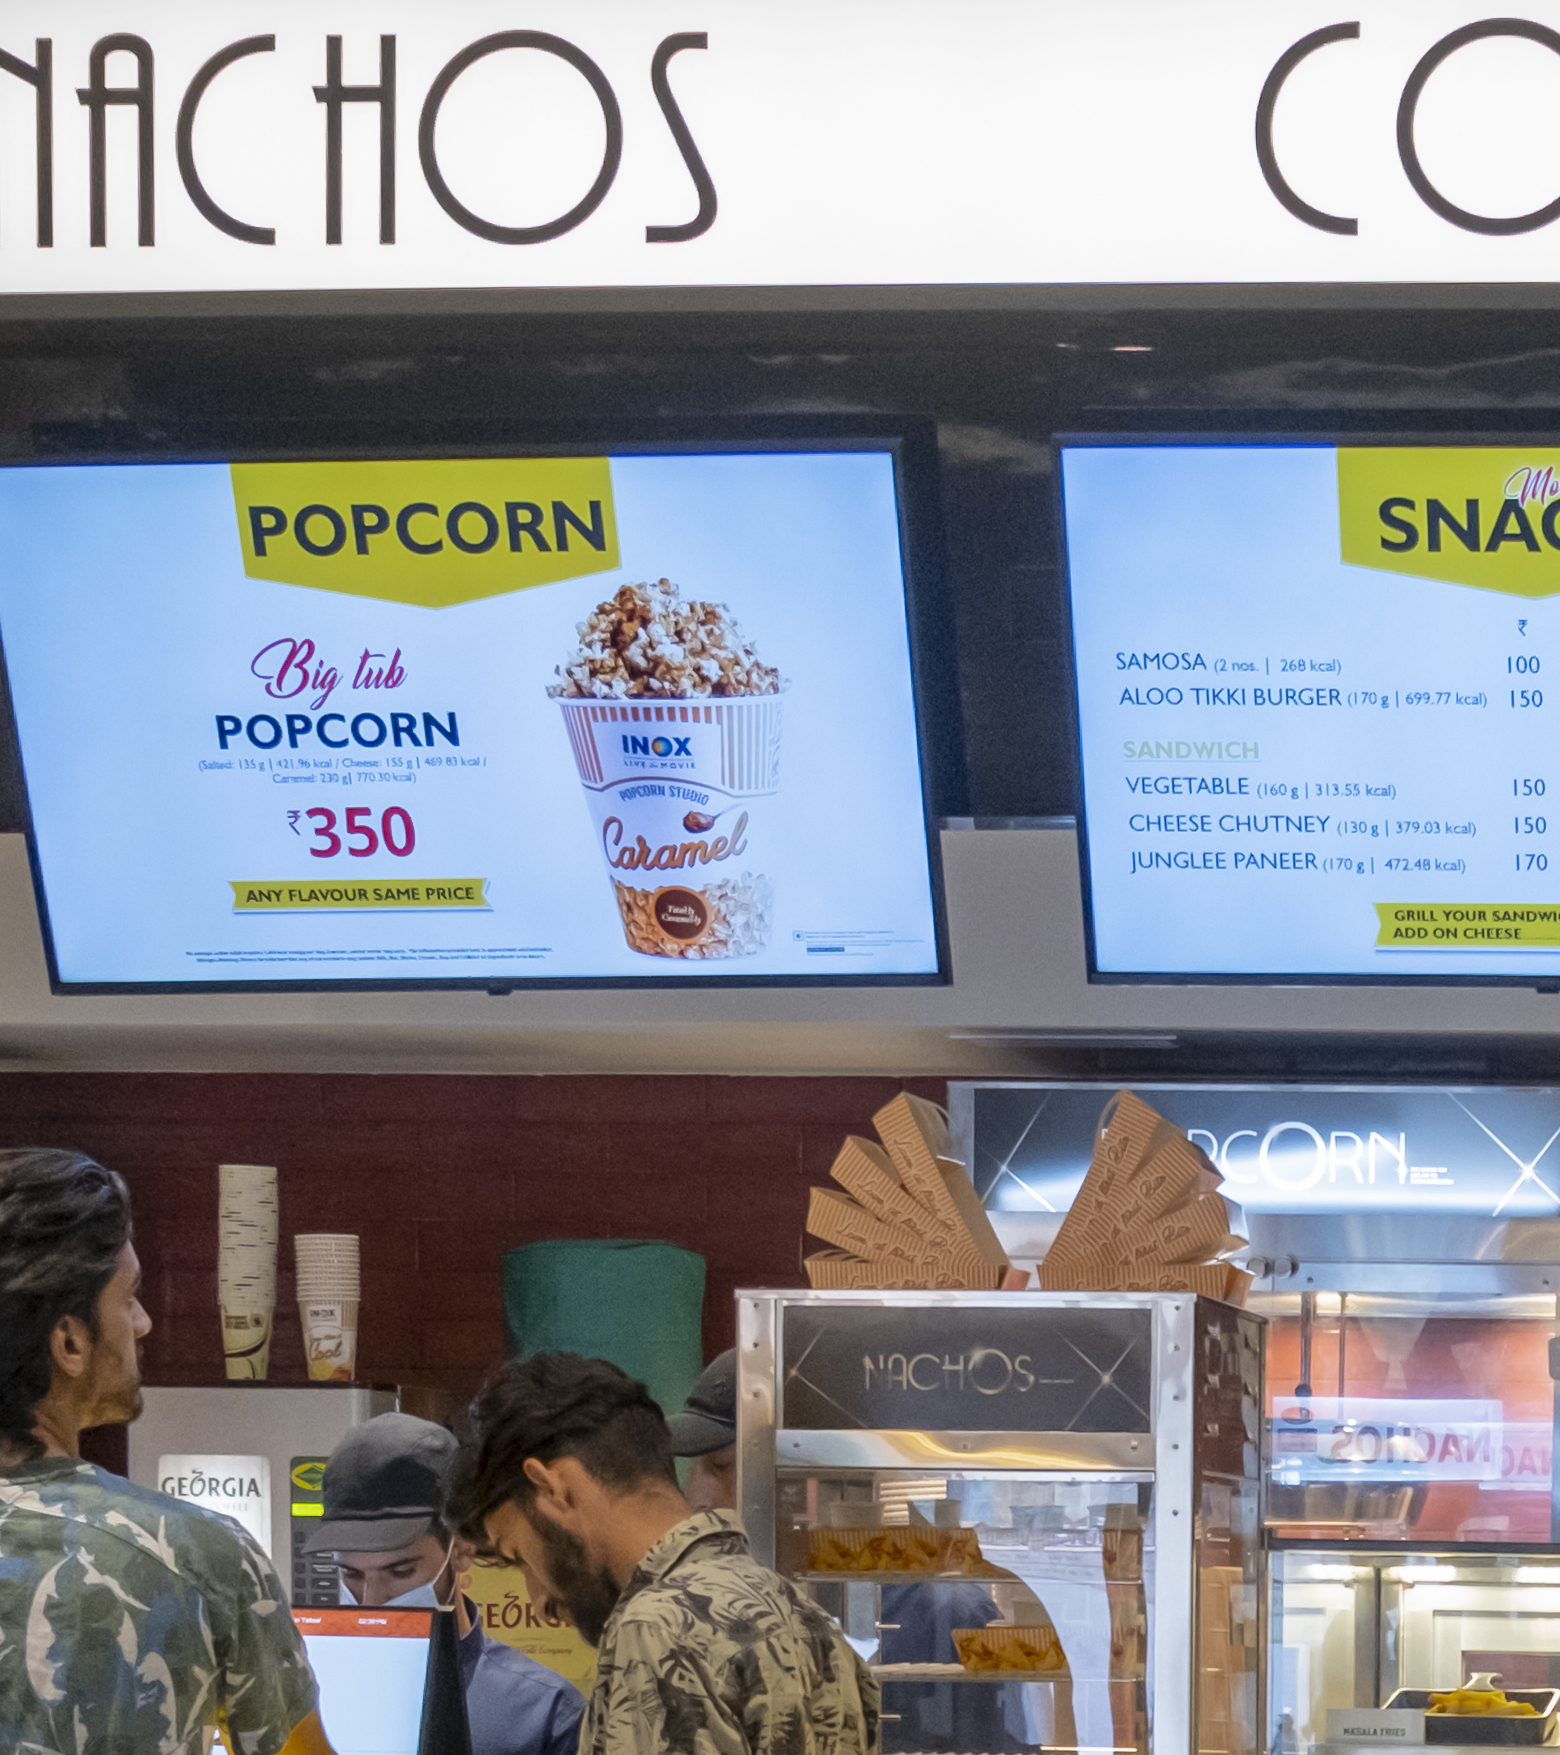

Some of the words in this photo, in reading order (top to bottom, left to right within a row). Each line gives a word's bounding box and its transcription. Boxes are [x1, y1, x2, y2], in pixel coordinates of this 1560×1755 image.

[248, 500, 608, 558] POPCORN
[250, 637, 345, 711] Big
[352, 647, 408, 690] tub
[1115, 652, 1207, 671] SAMOSA
[1280, 659, 1306, 673] 268
[1309, 658, 1342, 675] kcal)
[1506, 656, 1541, 675] 100
[1119, 688, 1183, 707] ALOO
[1190, 688, 1247, 706] TIKKI
[1254, 688, 1343, 706] BURGER
[1347, 691, 1378, 708] (170
[1405, 691, 1451, 706] 699.77
[1455, 691, 1488, 708] kcal)
[1510, 690, 1543, 708] 150
[215, 711, 461, 750] POPCORN
[622, 735, 693, 757] INOX
[1123, 741, 1260, 760] SANDWICH
[619, 785, 666, 801] POPCORN
[669, 785, 710, 806] STUDIO
[1125, 777, 1250, 796] VEGETABLE
[1257, 783, 1287, 799] (160
[1315, 783, 1361, 798] 313.55
[1365, 783, 1396, 800] kcal)
[1513, 779, 1546, 797] 150
[287, 806, 416, 858] ₹350
[1128, 814, 1212, 833] CHEESE
[1218, 814, 1331, 833] CHUTNEY
[1337, 821, 1368, 837] (130
[1395, 821, 1441, 836] 379.03
[1445, 821, 1477, 838] kcal)
[1514, 817, 1547, 835] 150
[603, 810, 749, 871] Caramel
[1130, 852, 1226, 875] JUNGLEE
[1234, 852, 1318, 871] PANEER
[1323, 858, 1354, 875] (170
[1384, 858, 1432, 872] 472.48
[1434, 858, 1466, 875] kcal)
[1515, 854, 1548, 872] 170
[246, 888, 284, 903] ANY
[287, 888, 369, 903] FLAVOUR
[373, 887, 420, 901] SAME
[425, 886, 474, 900] PRICE
[1394, 910, 1438, 923] GRILL
[1443, 910, 1487, 923] YOUR
[1393, 928, 1428, 939] ADD
[1433, 928, 1457, 939] ON
[1462, 928, 1522, 940] CHEESE
[862, 1347, 1035, 1396] NACHOS
[161, 1468, 262, 1497] GEORGIA
